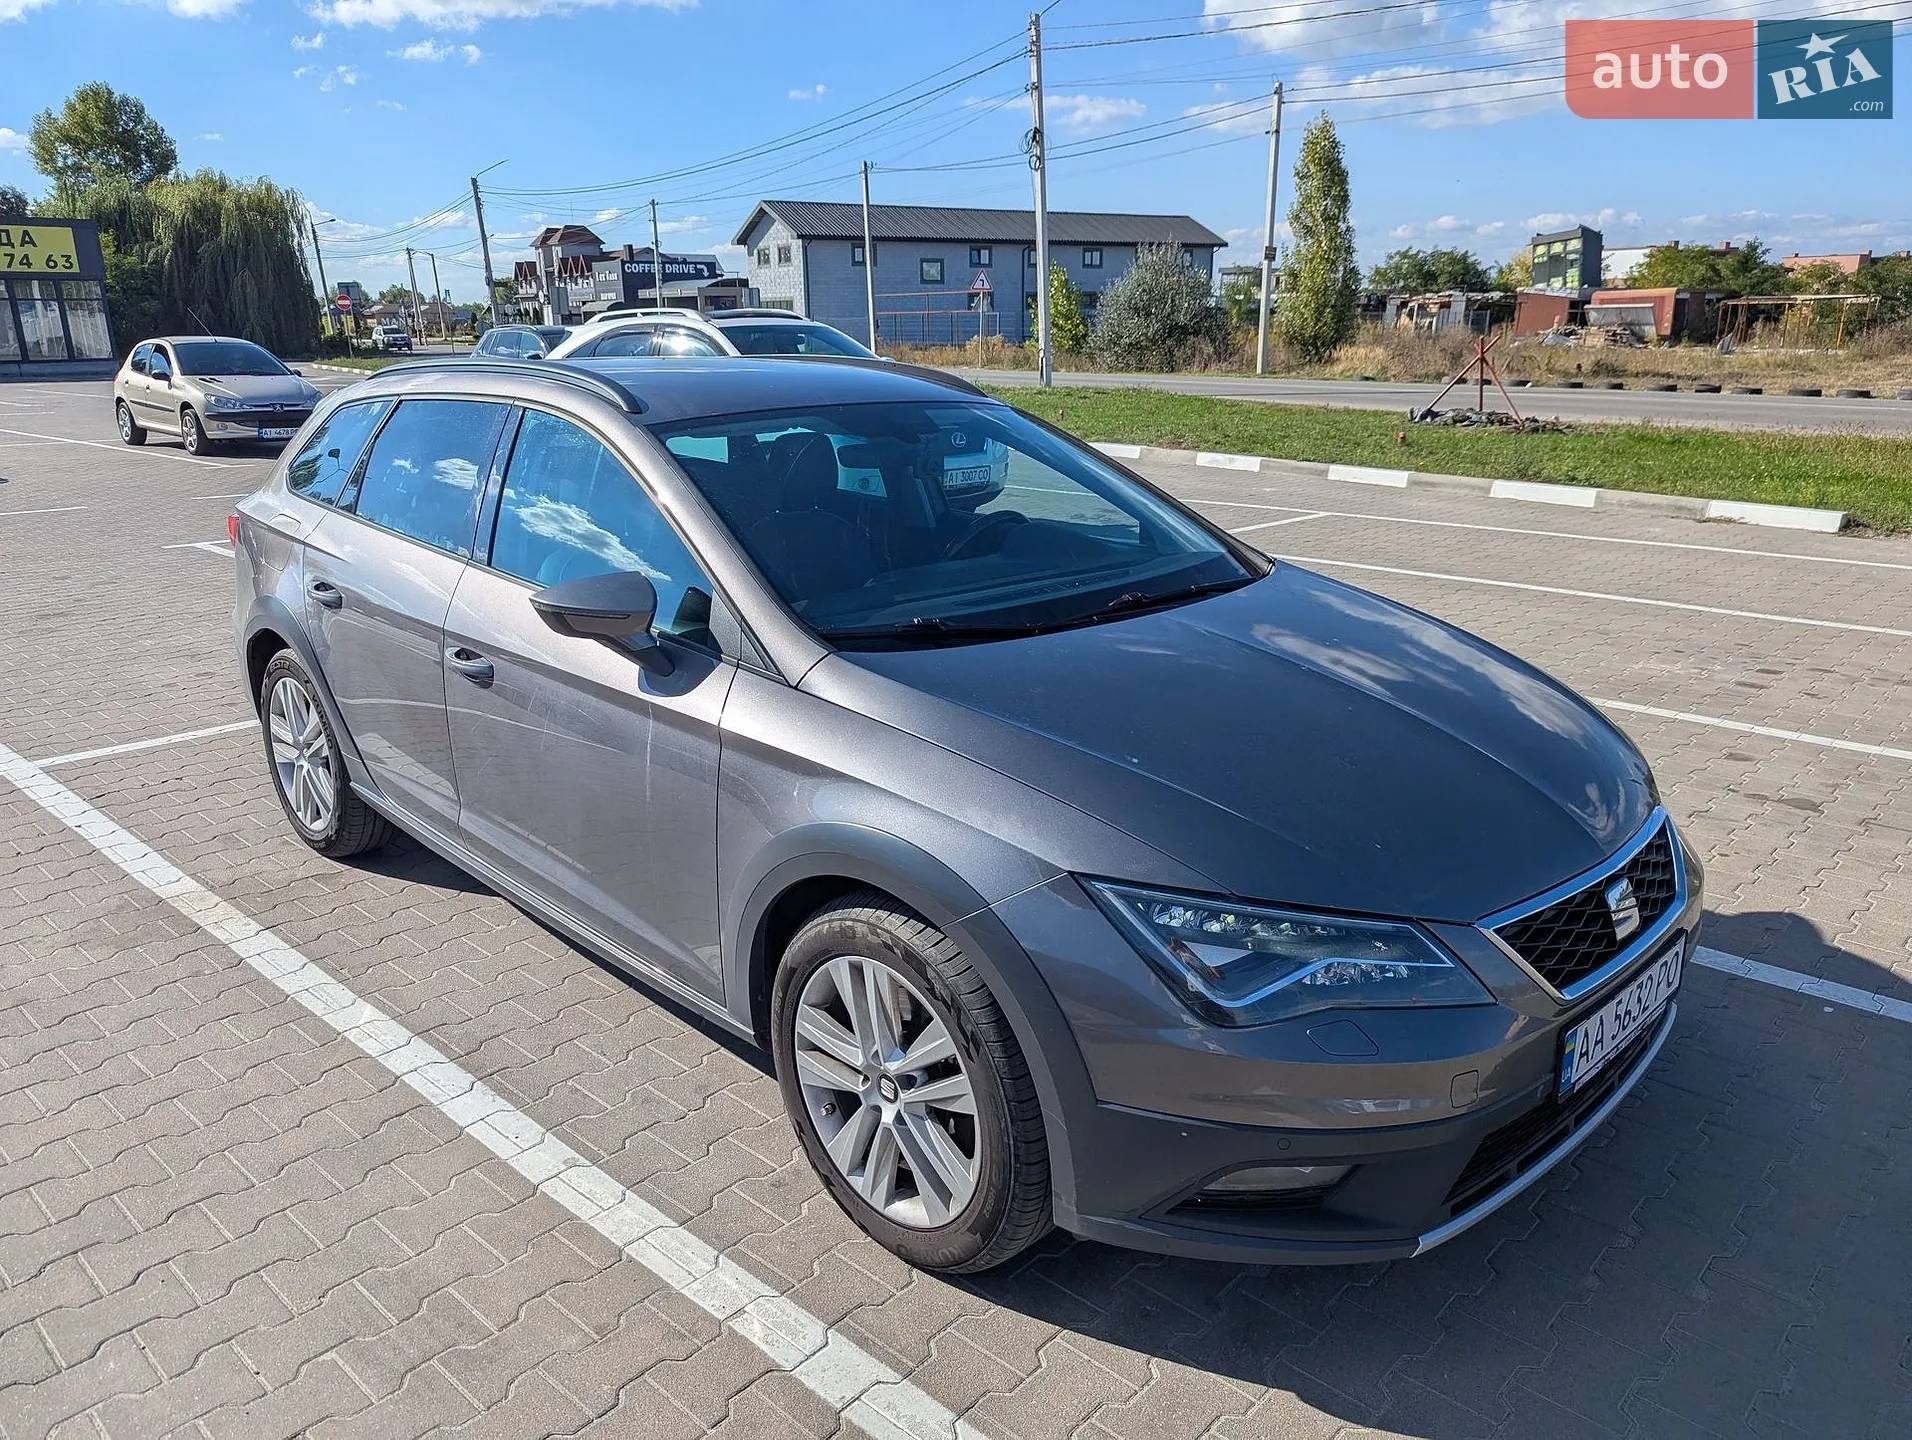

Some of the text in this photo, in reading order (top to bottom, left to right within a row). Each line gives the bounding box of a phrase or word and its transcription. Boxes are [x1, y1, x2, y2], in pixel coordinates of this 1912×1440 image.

[3, 253, 74, 270] 74 63
[624, 263, 696, 274] COFFEE DRIVE
[948, 471, 958, 484] AI
[978, 469, 989, 480] CO
[1575, 1013, 1604, 1074] AA
[1610, 973, 1654, 1041] 5632
[1655, 949, 1681, 1001] PO
